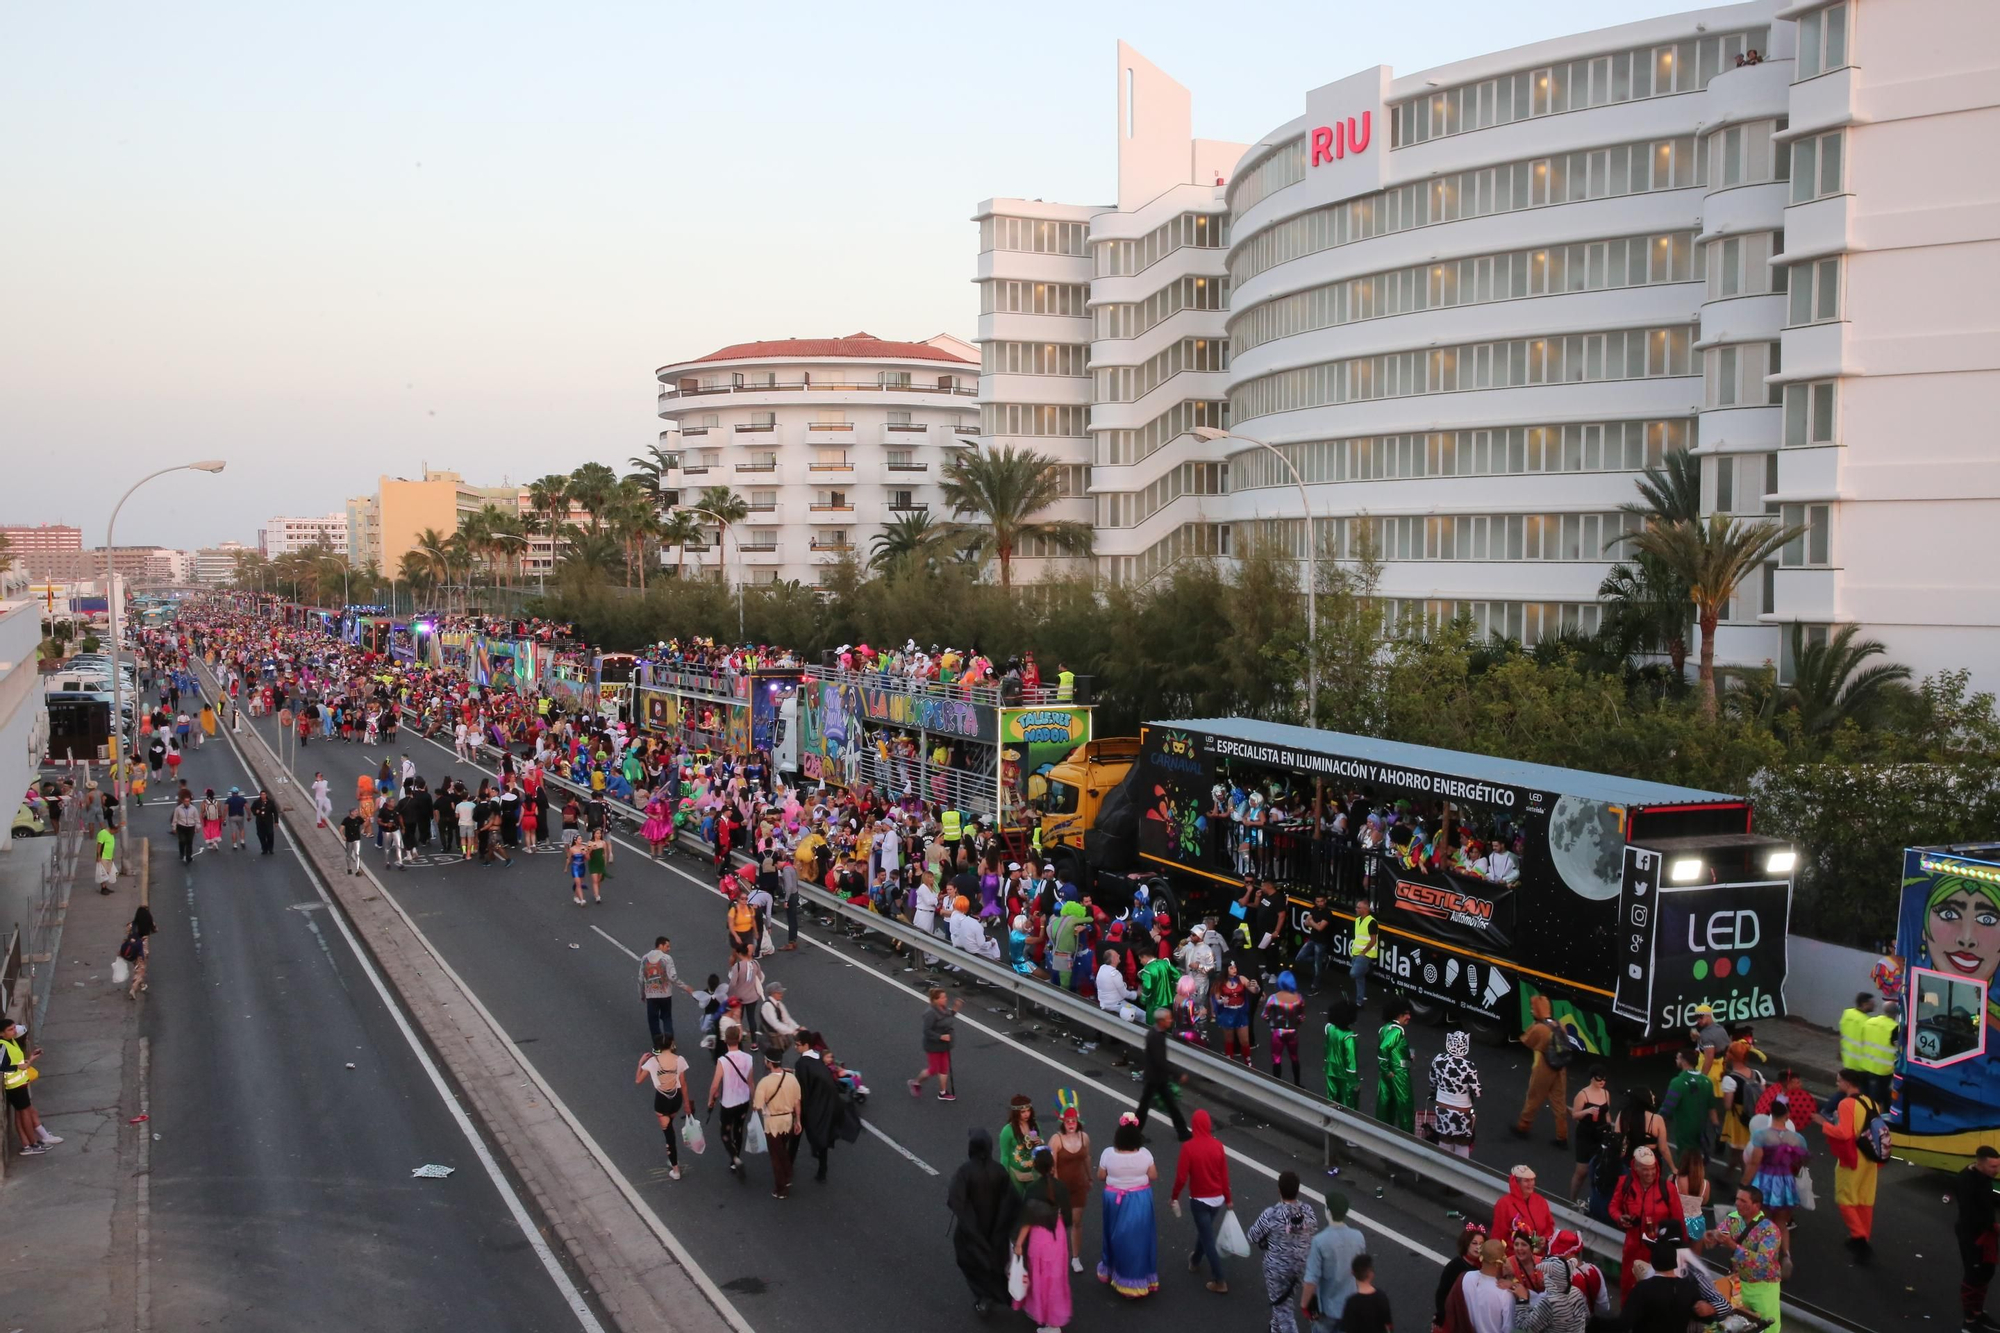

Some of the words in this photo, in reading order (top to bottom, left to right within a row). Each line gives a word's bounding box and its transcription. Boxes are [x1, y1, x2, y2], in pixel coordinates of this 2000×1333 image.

[1312, 111, 1370, 167] RIU
[869, 688, 888, 719] LA
[889, 693, 978, 736] INEXPERTA
[1017, 711, 1072, 729] TALLERES
[1024, 727, 1070, 743] NADOM
[1150, 752, 1204, 776] CARNAVAL
[1217, 739, 1279, 764] ESPECIALISTA
[1281, 751, 1294, 767] EN
[1296, 753, 1368, 779] ILUMINACIÓN
[1369, 766, 1378, 780] Y
[1379, 768, 1431, 791] AHORRO
[1433, 777, 1515, 807] ENERGÉTICO
[1529, 792, 1543, 802] LED
[1396, 881, 1492, 919] GESTICAN
[1292, 907, 1311, 935] LE
[1688, 910, 1760, 952] LED
[1920, 1036, 1936, 1051] 94
